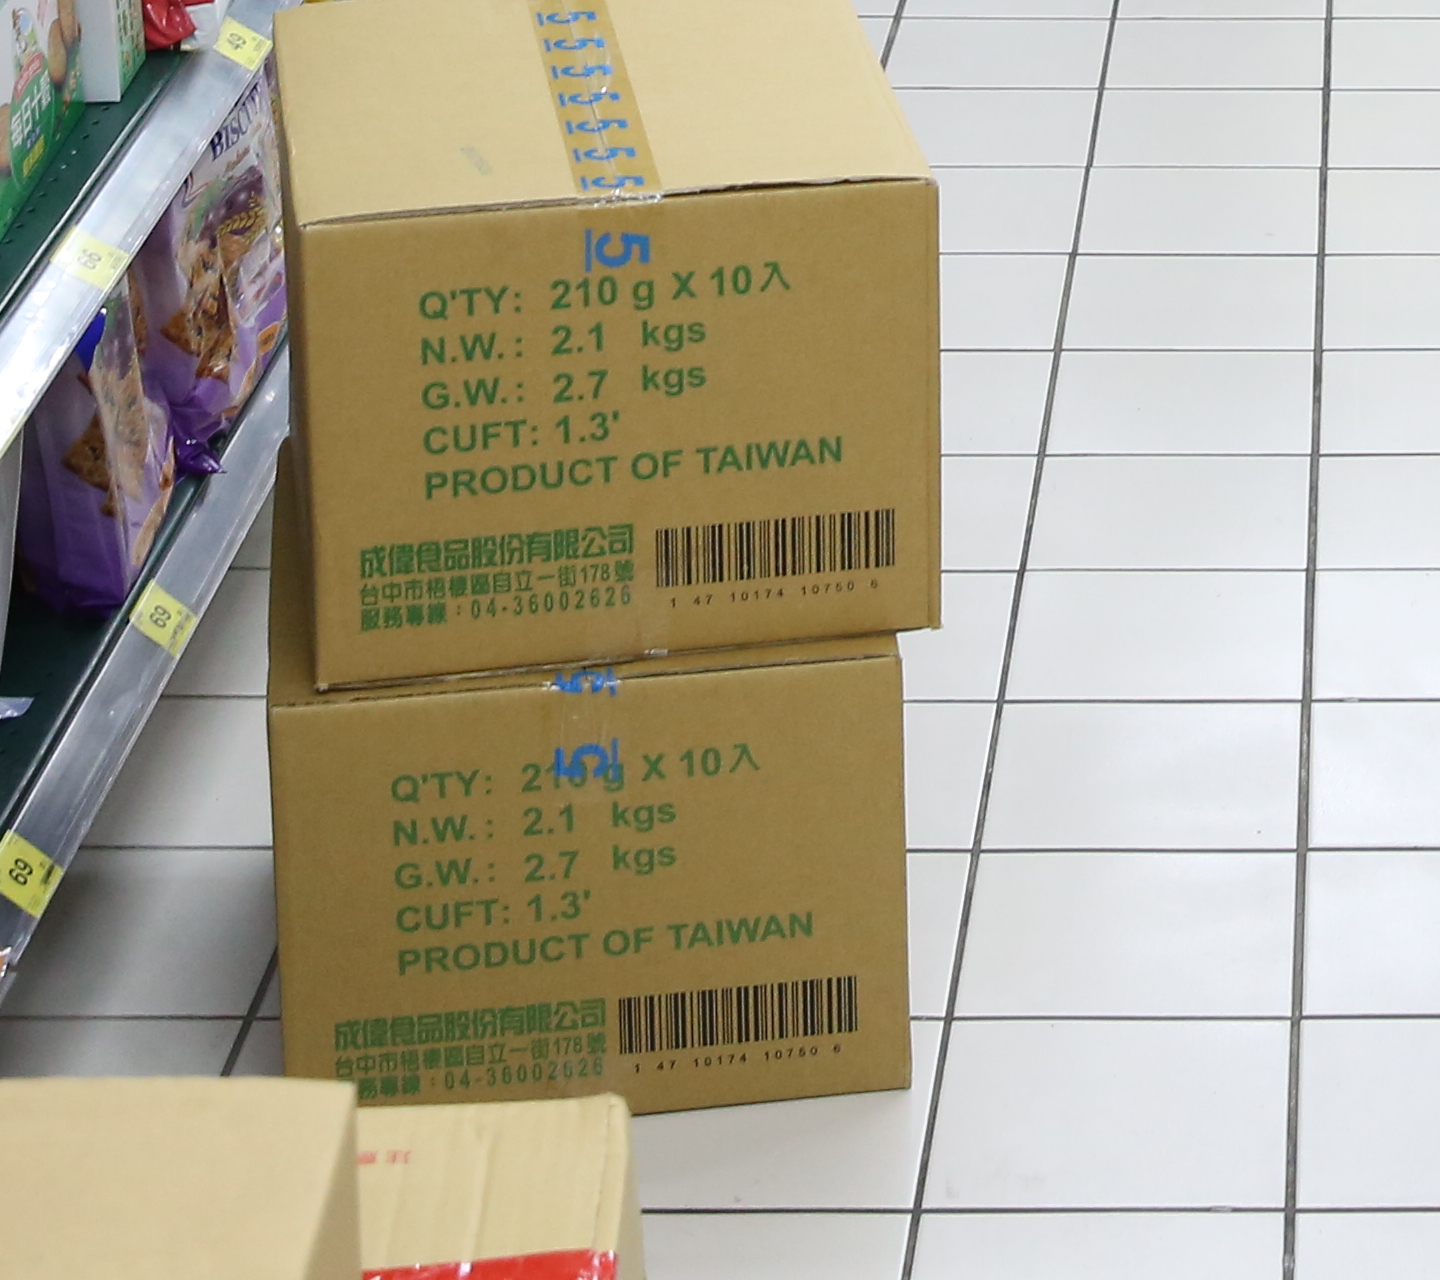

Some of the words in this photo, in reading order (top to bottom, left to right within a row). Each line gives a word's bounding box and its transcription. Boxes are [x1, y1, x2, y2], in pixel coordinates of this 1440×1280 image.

[419, 286, 523, 321] Q'TY:
[550, 276, 618, 310] 210
[633, 280, 656, 310] g
[671, 271, 697, 300] X
[710, 262, 792, 298] 10入
[421, 330, 524, 366] N.W.:
[551, 322, 607, 356] 2.1
[641, 320, 707, 352] kgs
[422, 376, 524, 412] G.W.:
[552, 368, 610, 402] 2.7
[641, 364, 707, 397] kgs
[423, 420, 539, 458] CUFT:
[557, 410, 620, 445] 1.3'
[425, 455, 618, 501] PRODUCT
[632, 449, 680, 481] OF
[696, 437, 845, 474] TAIWAN
[360, 522, 635, 579] 成偉食品股份有限公司
[391, 768, 493, 803] Q'TY:
[642, 754, 667, 781] X
[679, 743, 761, 778] 10入
[393, 815, 495, 848] N.W.:
[522, 806, 576, 837] 2.1
[611, 801, 677, 833] kgs
[395, 859, 497, 892] G.W.:
[523, 852, 579, 883] 2.7
[611, 843, 678, 877] kgs
[396, 899, 510, 934] CUFT:
[527, 890, 591, 923] 1.3'
[398, 933, 591, 977] PRODUCT
[602, 927, 653, 958] OF
[666, 912, 815, 950] TAIWAN
[334, 997, 607, 1053] 成偉食品股份有限公司
